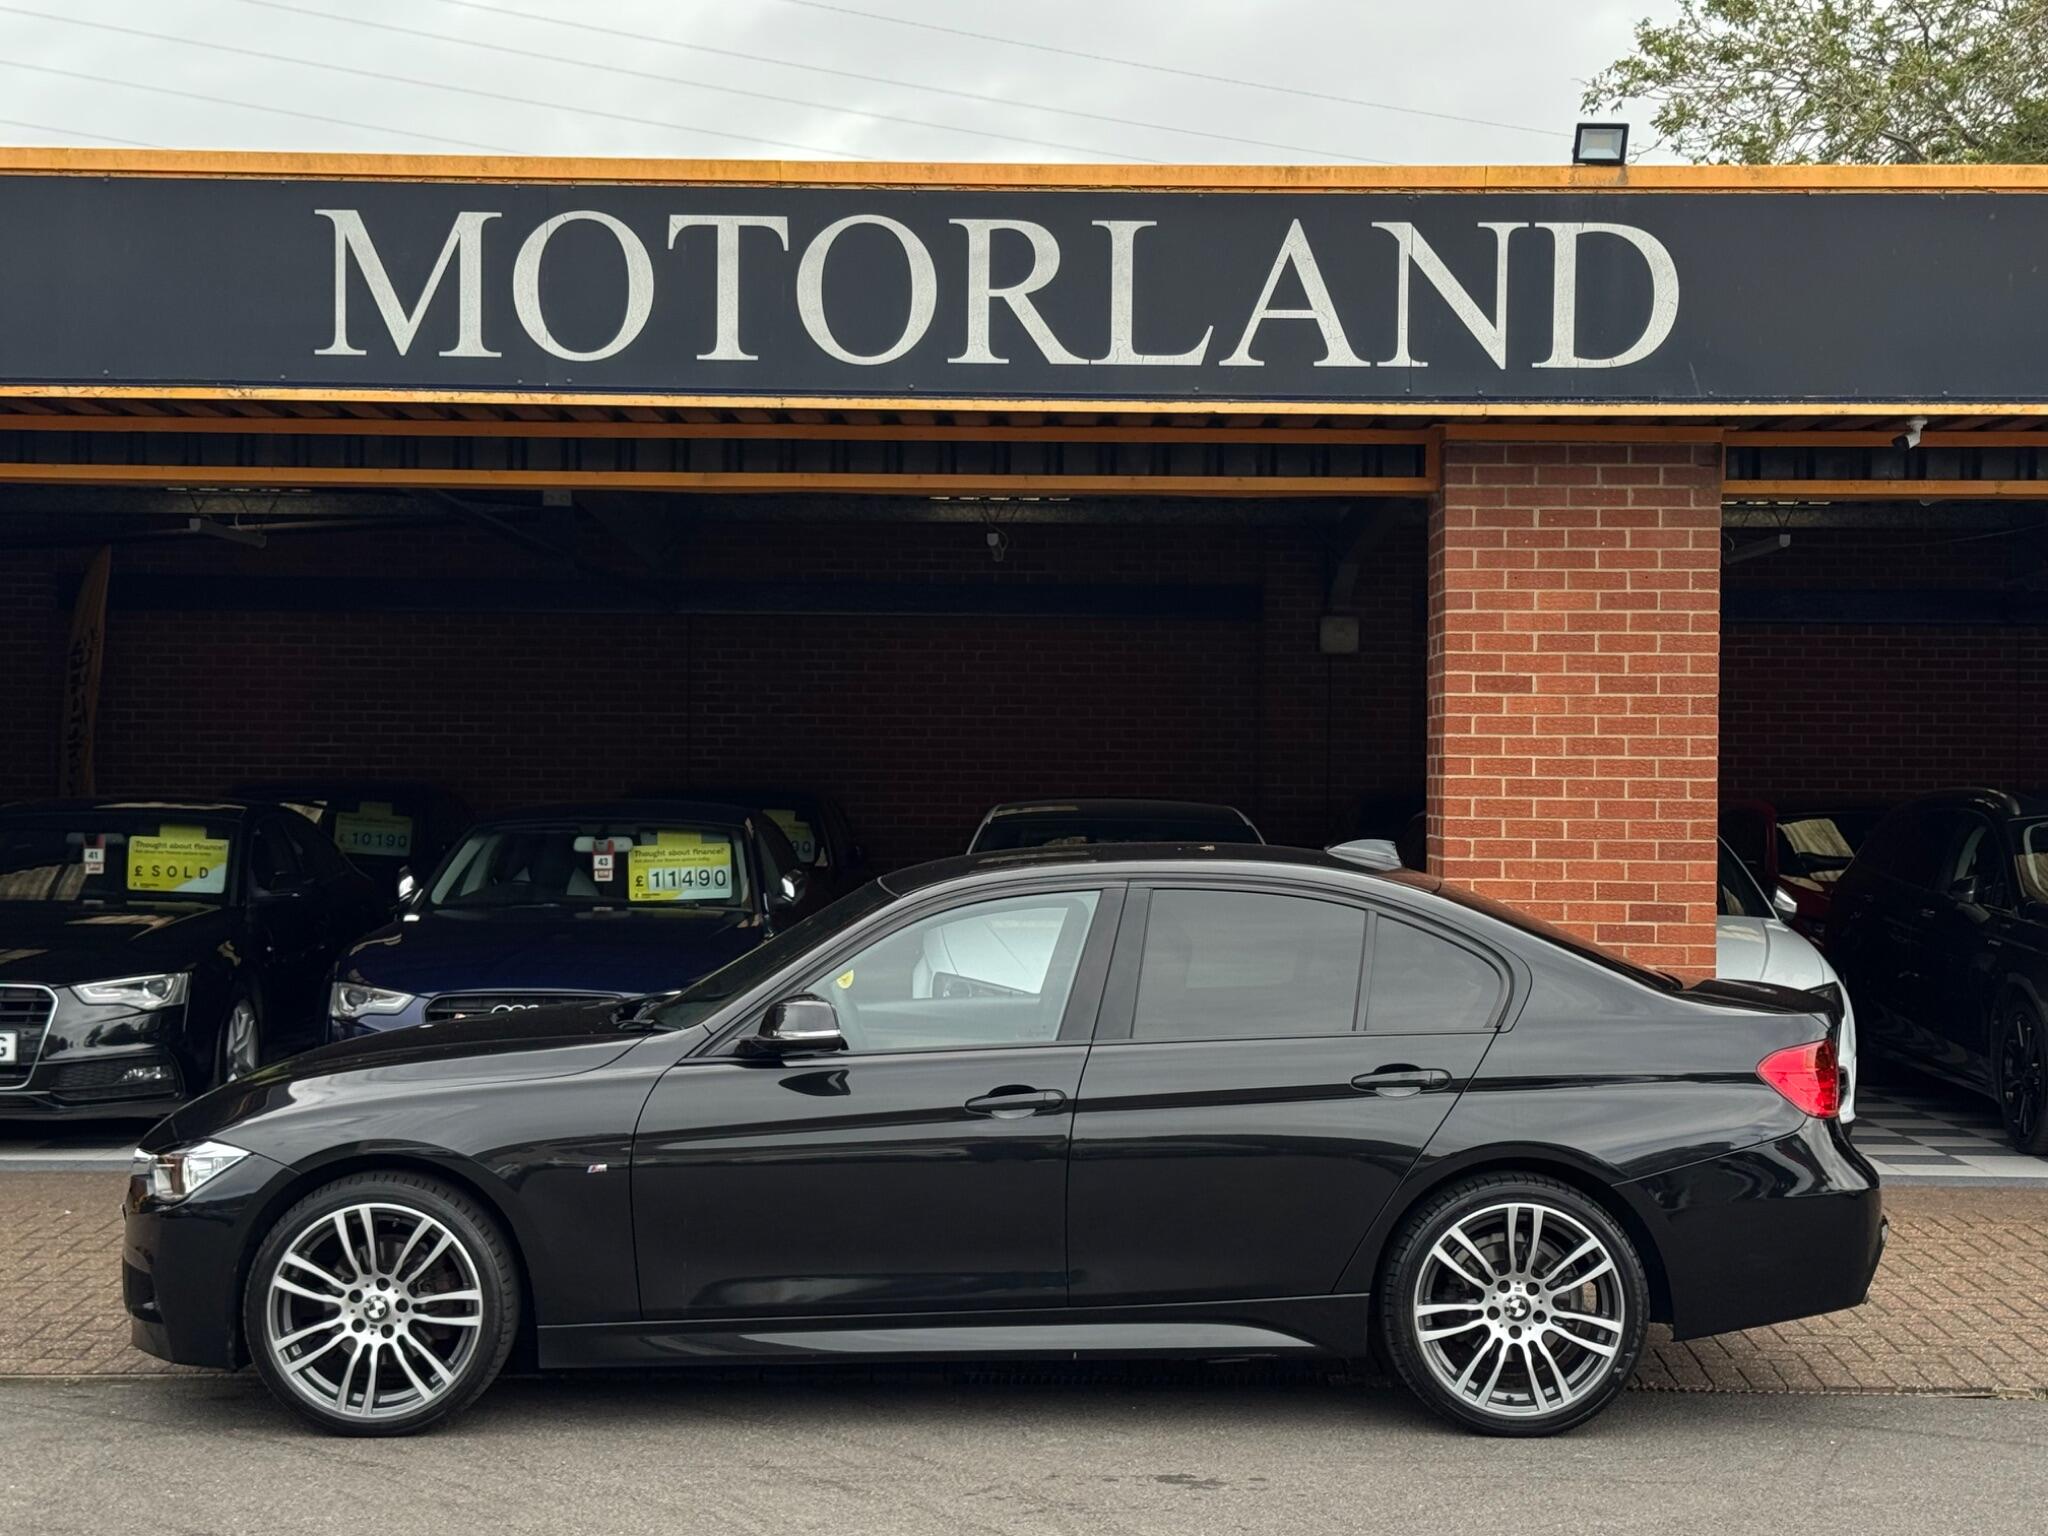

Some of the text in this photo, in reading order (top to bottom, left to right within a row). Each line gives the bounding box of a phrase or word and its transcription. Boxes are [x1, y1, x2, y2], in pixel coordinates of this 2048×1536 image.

[315, 210, 1679, 369] MOTORLAND
[135, 840, 167, 850] Thought
[169, 841, 192, 850] about
[352, 832, 408, 848] 10190
[634, 847, 726, 859] Thought about finance?
[151, 864, 209, 879] SOLD
[652, 869, 727, 887] 11490
